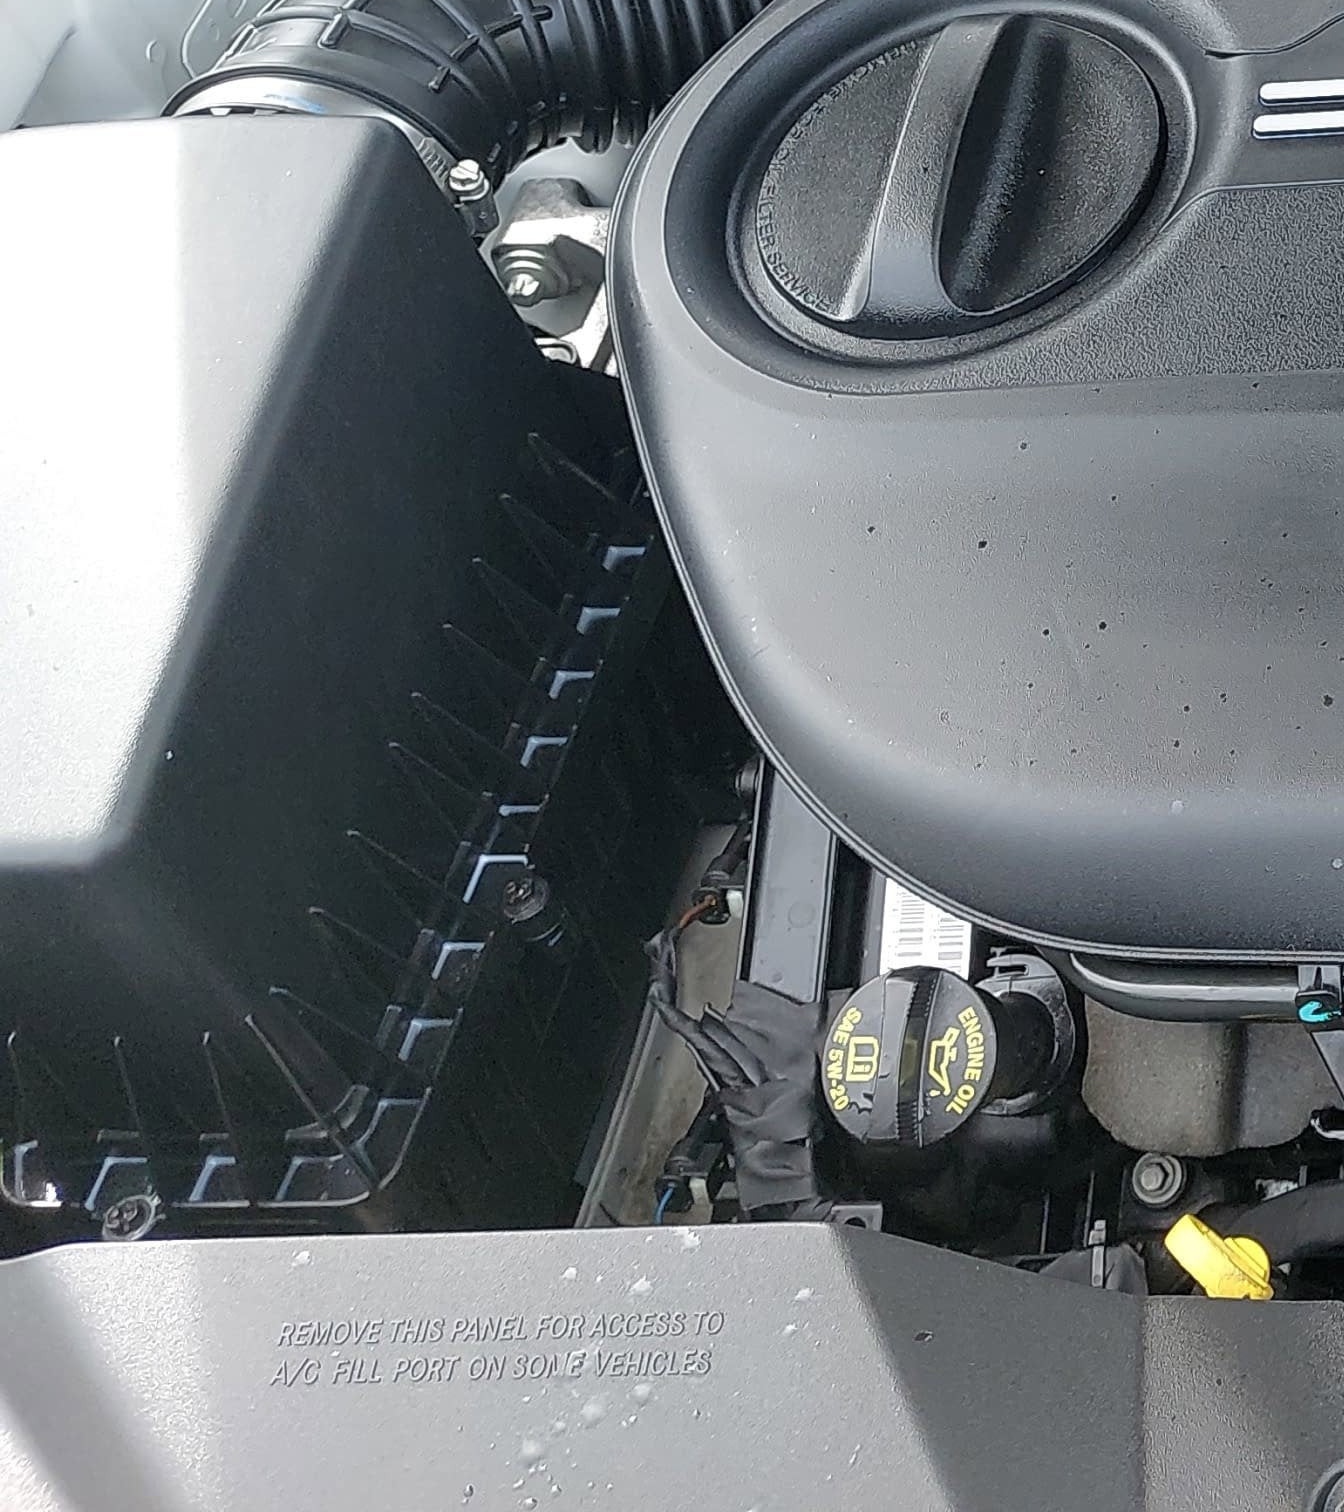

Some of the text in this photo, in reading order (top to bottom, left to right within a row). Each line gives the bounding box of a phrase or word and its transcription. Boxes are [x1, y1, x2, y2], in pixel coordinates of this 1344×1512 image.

[757, 179, 777, 250] FILTER
[766, 251, 833, 314] SERVICE
[827, 1007, 862, 1111] SAE 5W-20
[945, 1006, 985, 1115] ENGINE OIL
[277, 1311, 726, 1347] REMOVE THIS PANEL FOR ACCESS TO
[270, 1349, 713, 1387] A/C FILL PORT ON SOME VEHICLES
